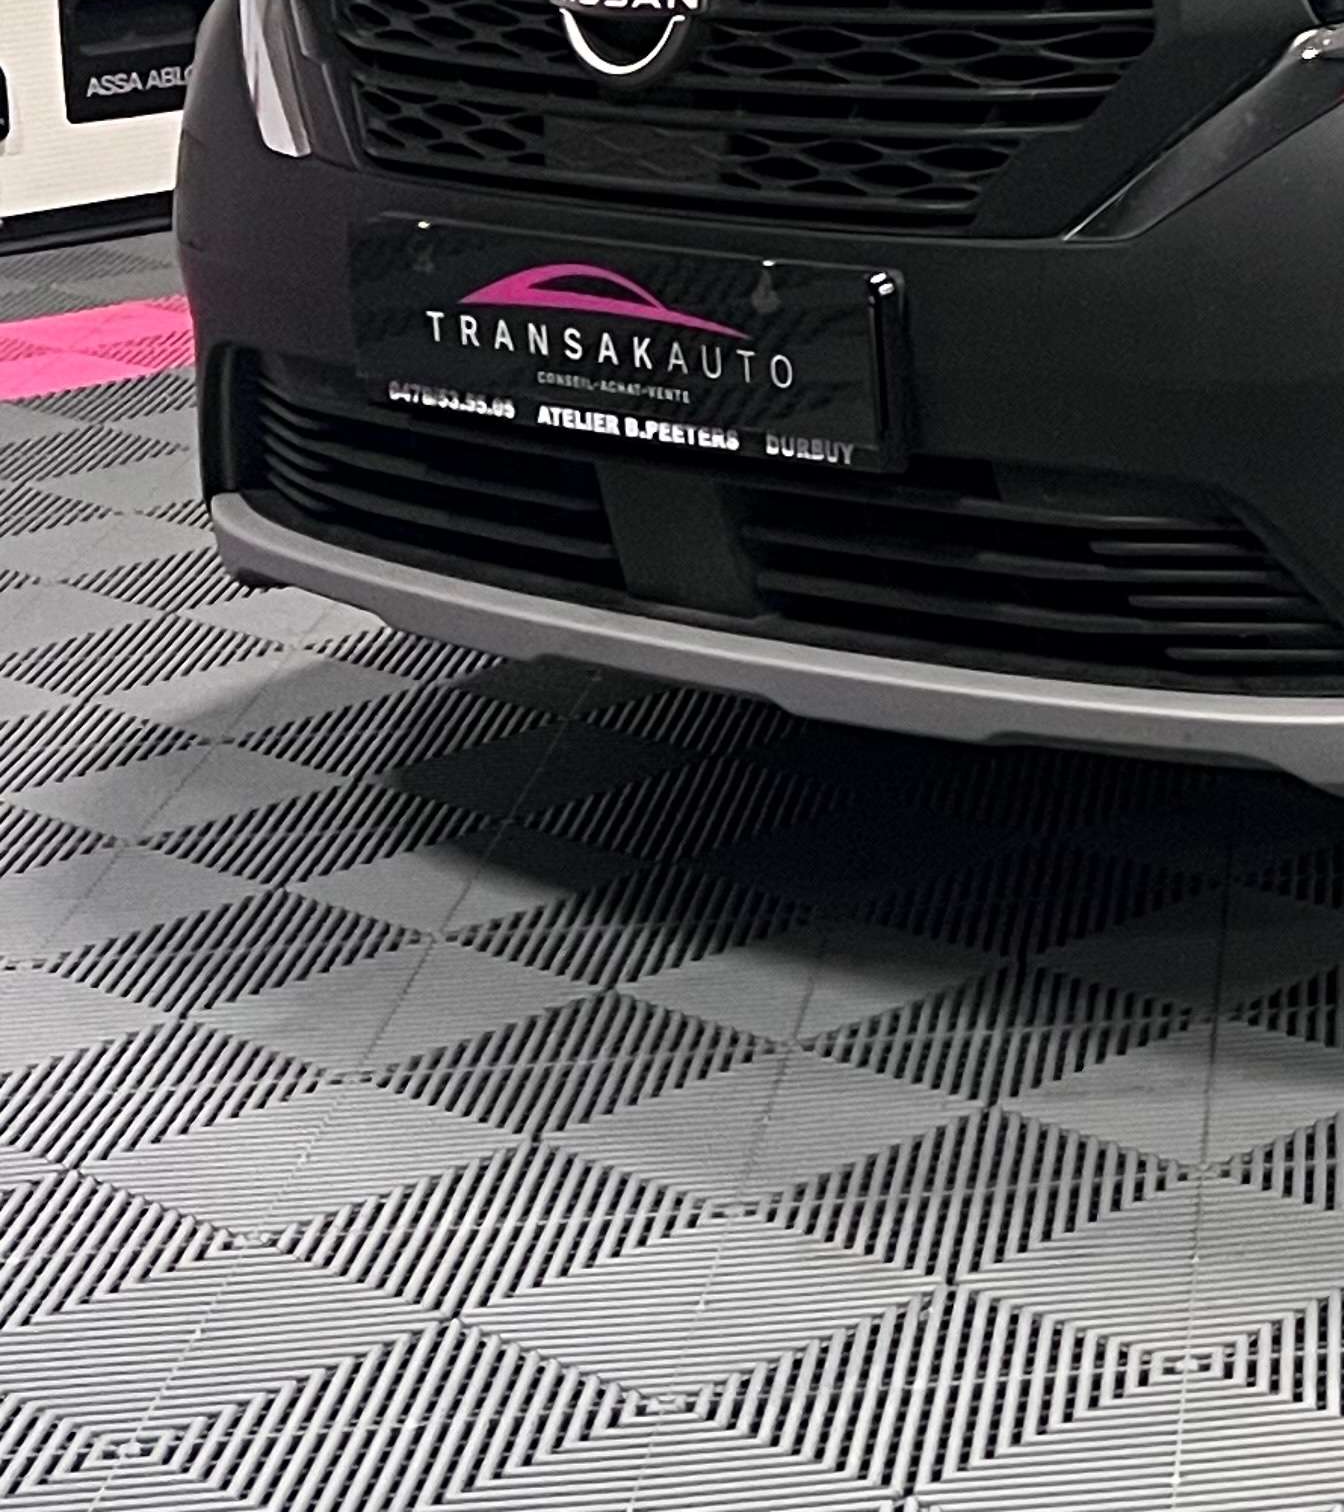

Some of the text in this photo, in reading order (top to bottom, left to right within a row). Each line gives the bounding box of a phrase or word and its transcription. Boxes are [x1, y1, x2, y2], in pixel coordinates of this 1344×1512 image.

[86, 71, 143, 97] ASSA
[425, 310, 794, 388] TRANSAKAUTO
[537, 404, 621, 437] ATELIER
[624, 416, 740, 452] B.PEETERS
[765, 433, 855, 466] DURBUY
